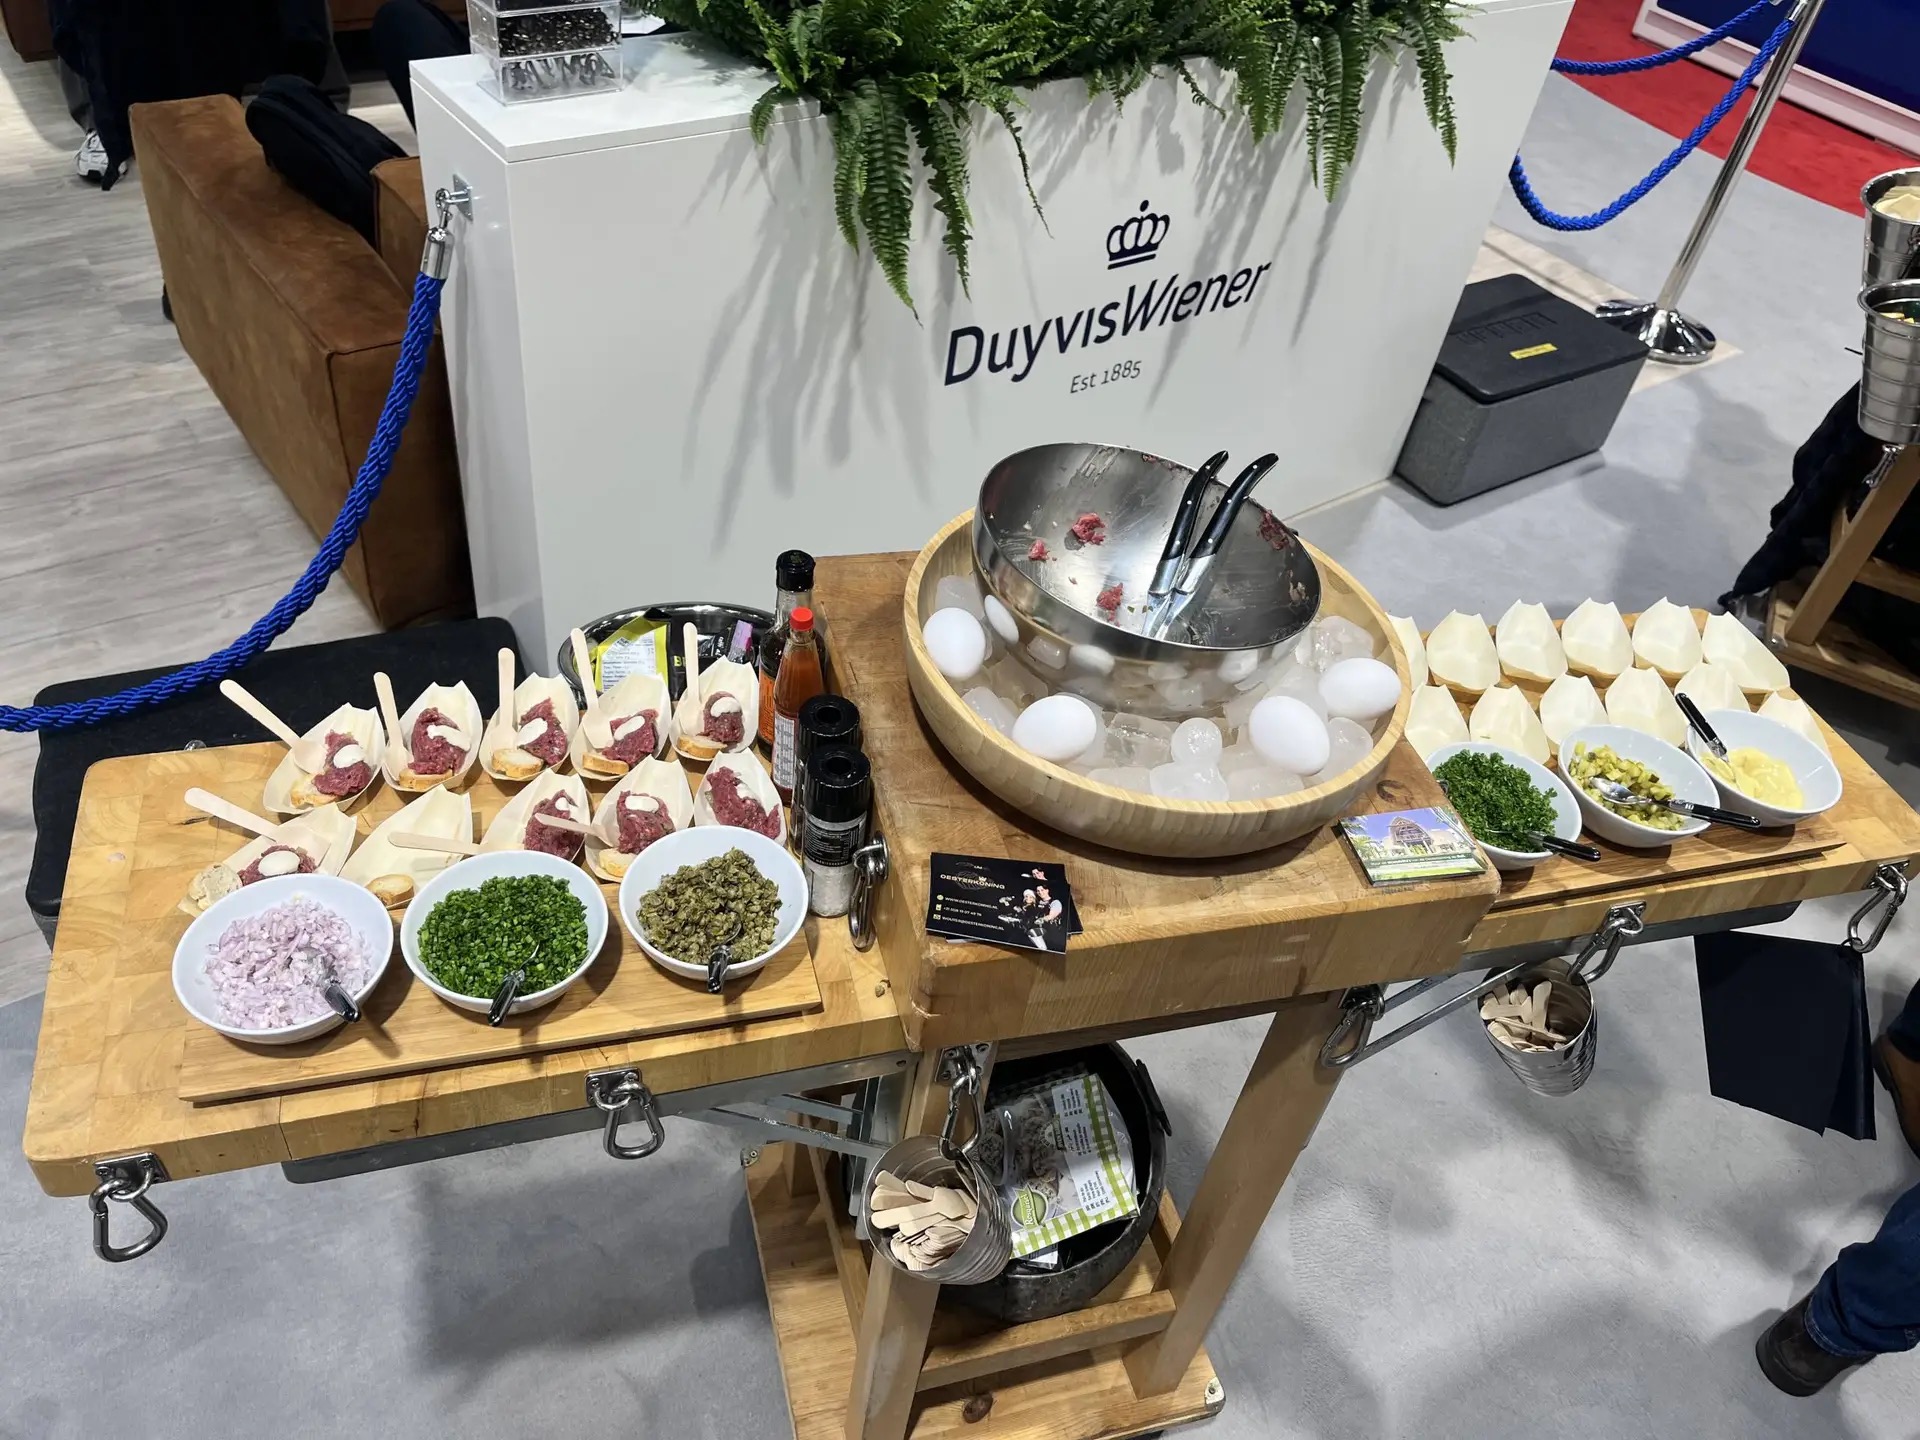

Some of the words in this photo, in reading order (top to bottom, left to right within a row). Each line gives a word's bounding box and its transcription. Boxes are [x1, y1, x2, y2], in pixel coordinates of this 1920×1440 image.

[943, 261, 1273, 387] DuyvisWiener
[1070, 374, 1096, 394] Est
[1101, 360, 1143, 386] 1885
